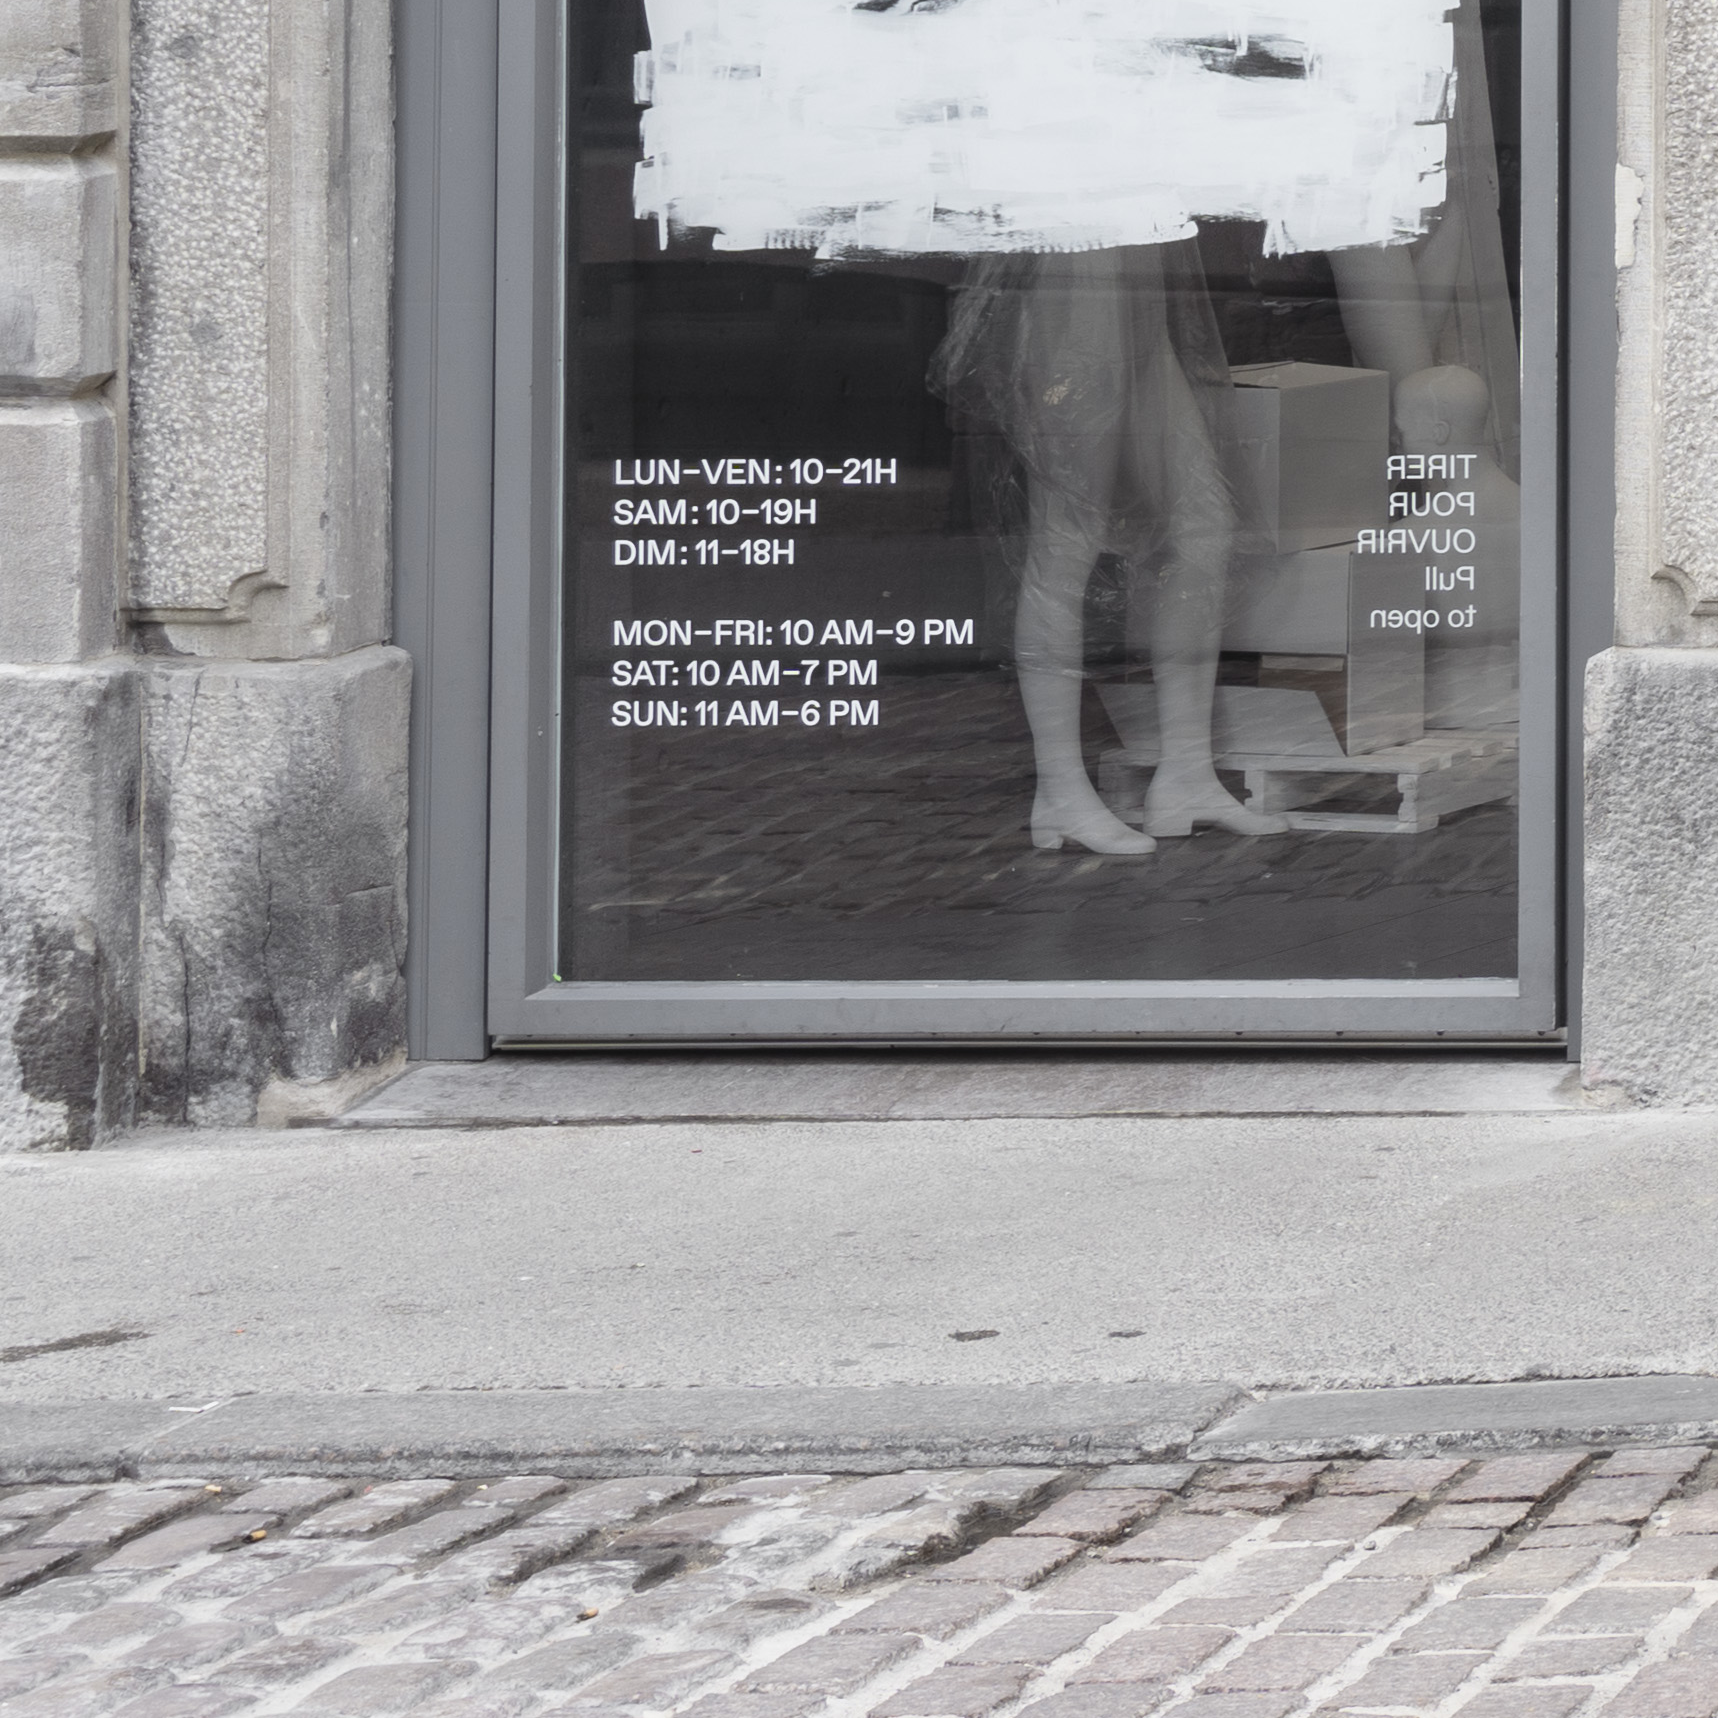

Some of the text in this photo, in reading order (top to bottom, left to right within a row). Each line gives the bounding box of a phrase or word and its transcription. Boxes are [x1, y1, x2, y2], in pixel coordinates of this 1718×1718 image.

[779, 618, 814, 646] 10
[924, 618, 974, 646] PM
[611, 659, 679, 687] SAT:
[686, 659, 721, 687] 10
[827, 659, 878, 687] PM
[611, 699, 688, 727] SUN:
[694, 699, 719, 727] 11
[829, 699, 879, 727] PM
